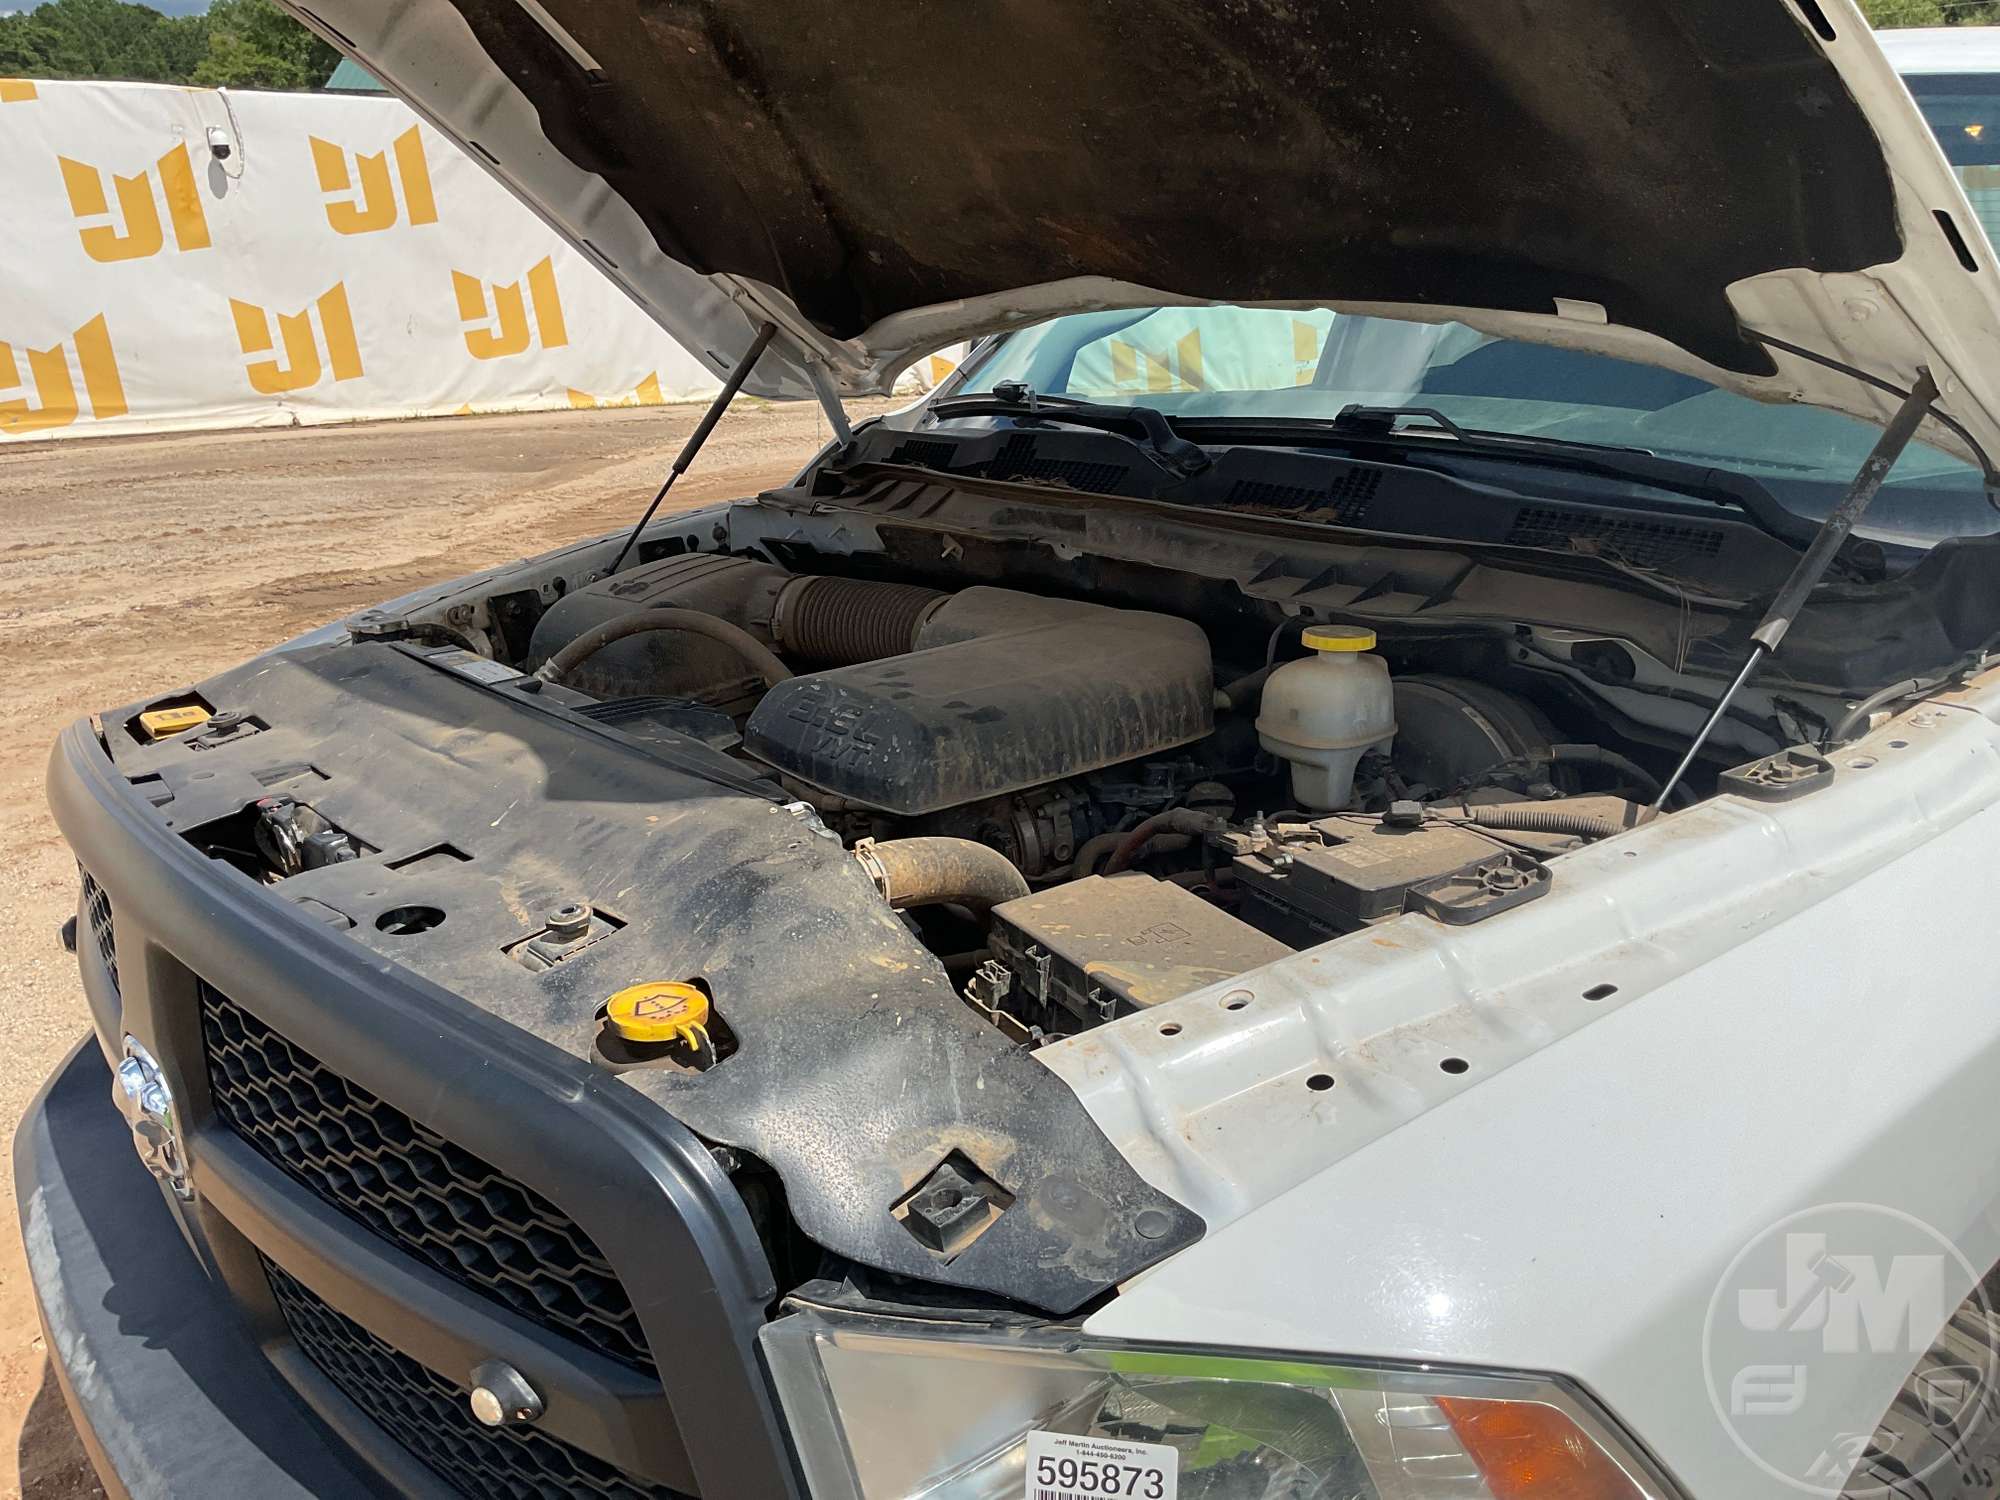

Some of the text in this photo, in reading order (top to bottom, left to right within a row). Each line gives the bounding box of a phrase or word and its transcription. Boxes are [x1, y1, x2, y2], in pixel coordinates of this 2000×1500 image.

[1053, 1438, 1148, 1456] Jeff Martin Auctioneers, Inc.
[1037, 1455, 1164, 1499] 595873
